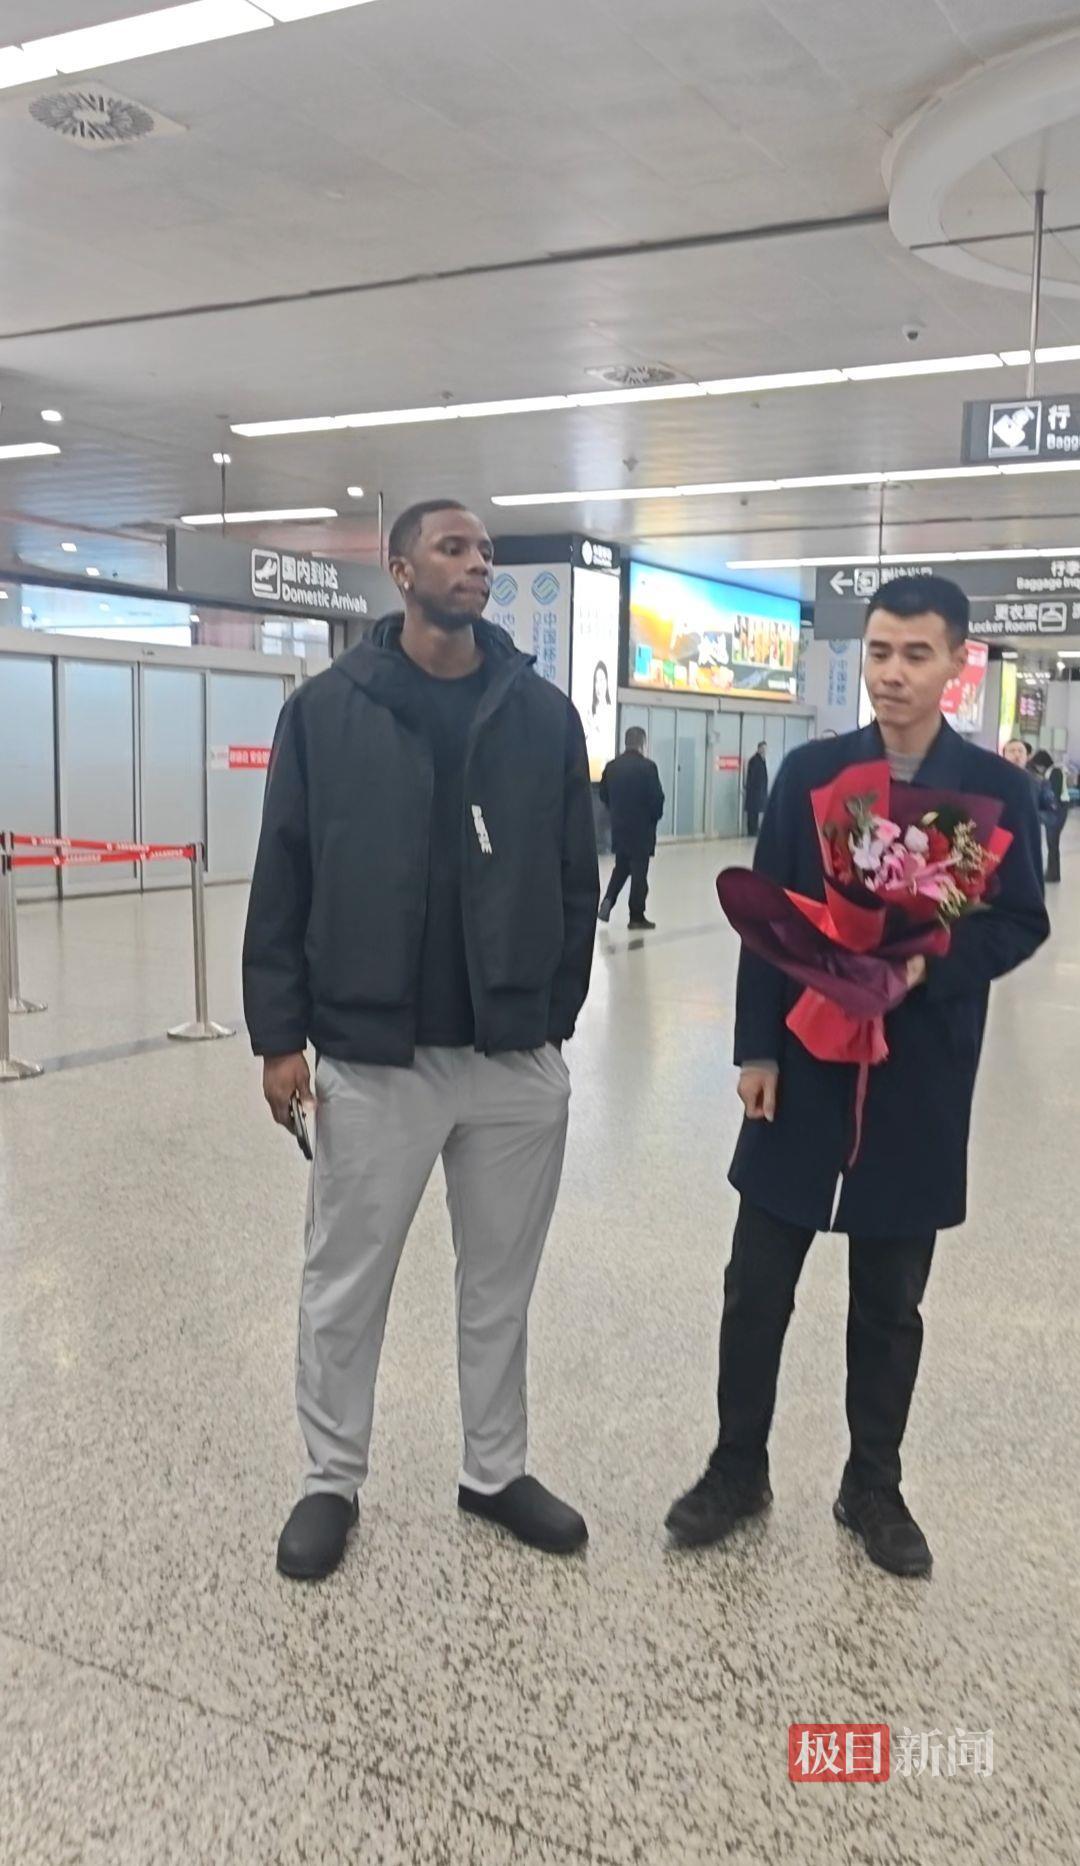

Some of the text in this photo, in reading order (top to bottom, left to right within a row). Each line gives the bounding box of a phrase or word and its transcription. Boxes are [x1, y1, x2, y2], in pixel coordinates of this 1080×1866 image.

[281, 555, 338, 590] 国内到达
[1016, 576, 1062, 592] Baggage
[281, 583, 367, 614] Domestic Arrivals
[994, 603, 1038, 621] 更衣室
[968, 619, 1037, 634] Locker Room
